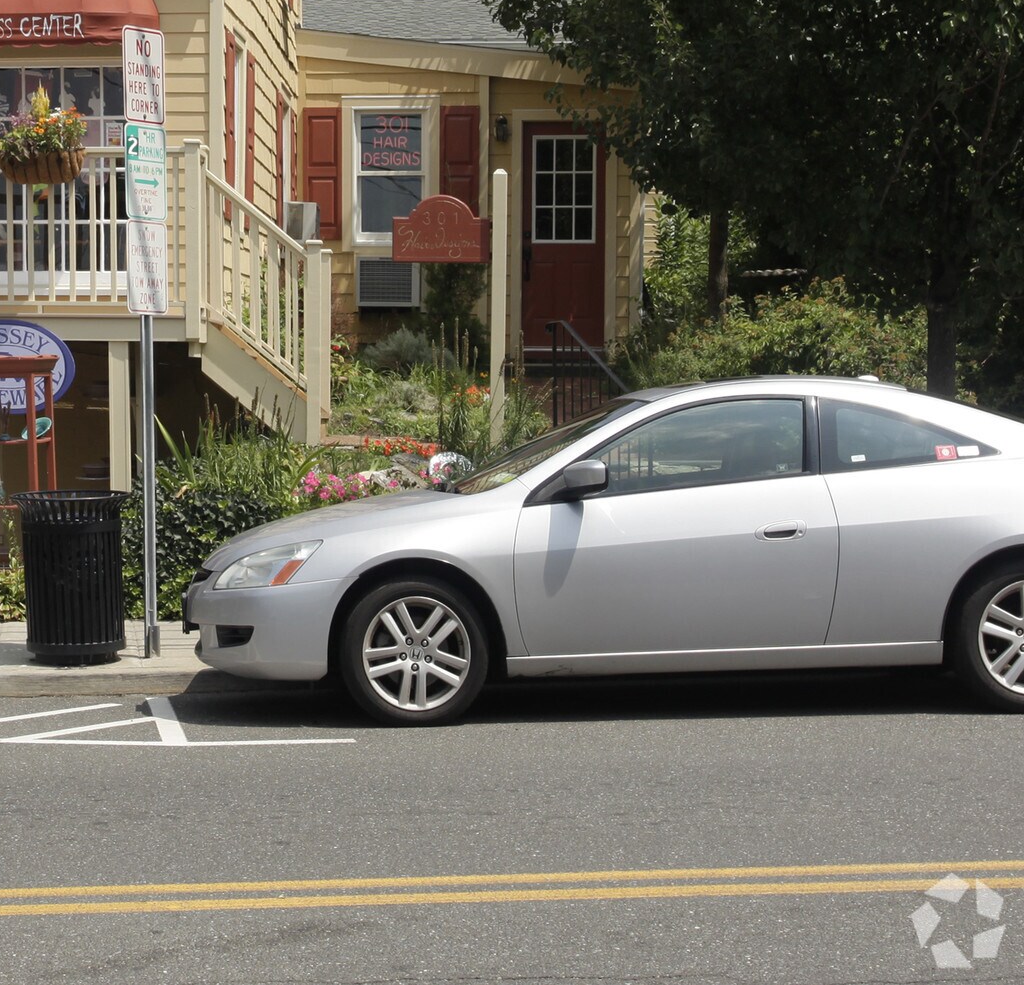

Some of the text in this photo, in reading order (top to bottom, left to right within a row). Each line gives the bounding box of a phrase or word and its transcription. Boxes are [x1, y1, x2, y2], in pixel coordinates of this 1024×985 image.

[20, 14, 85, 39] CENTER
[136, 39, 151, 57] NO
[128, 62, 161, 79] STANDING
[129, 80, 160, 97] HERE TO
[131, 98, 159, 115] CORNER
[375, 116, 410, 134] 301
[128, 131, 156, 156] 2 HR
[373, 136, 407, 149] HAIR
[139, 146, 164, 160] PARKING
[363, 151, 421, 167] DESIGNS
[143, 165, 150, 175] TO
[422, 211, 458, 225] 301
[138, 229, 156, 242] SNOW
[131, 244, 163, 258] EMERGENCY
[136, 260, 158, 274] STREET
[147, 277, 164, 290] AWAY
[140, 293, 156, 305] ZONE
